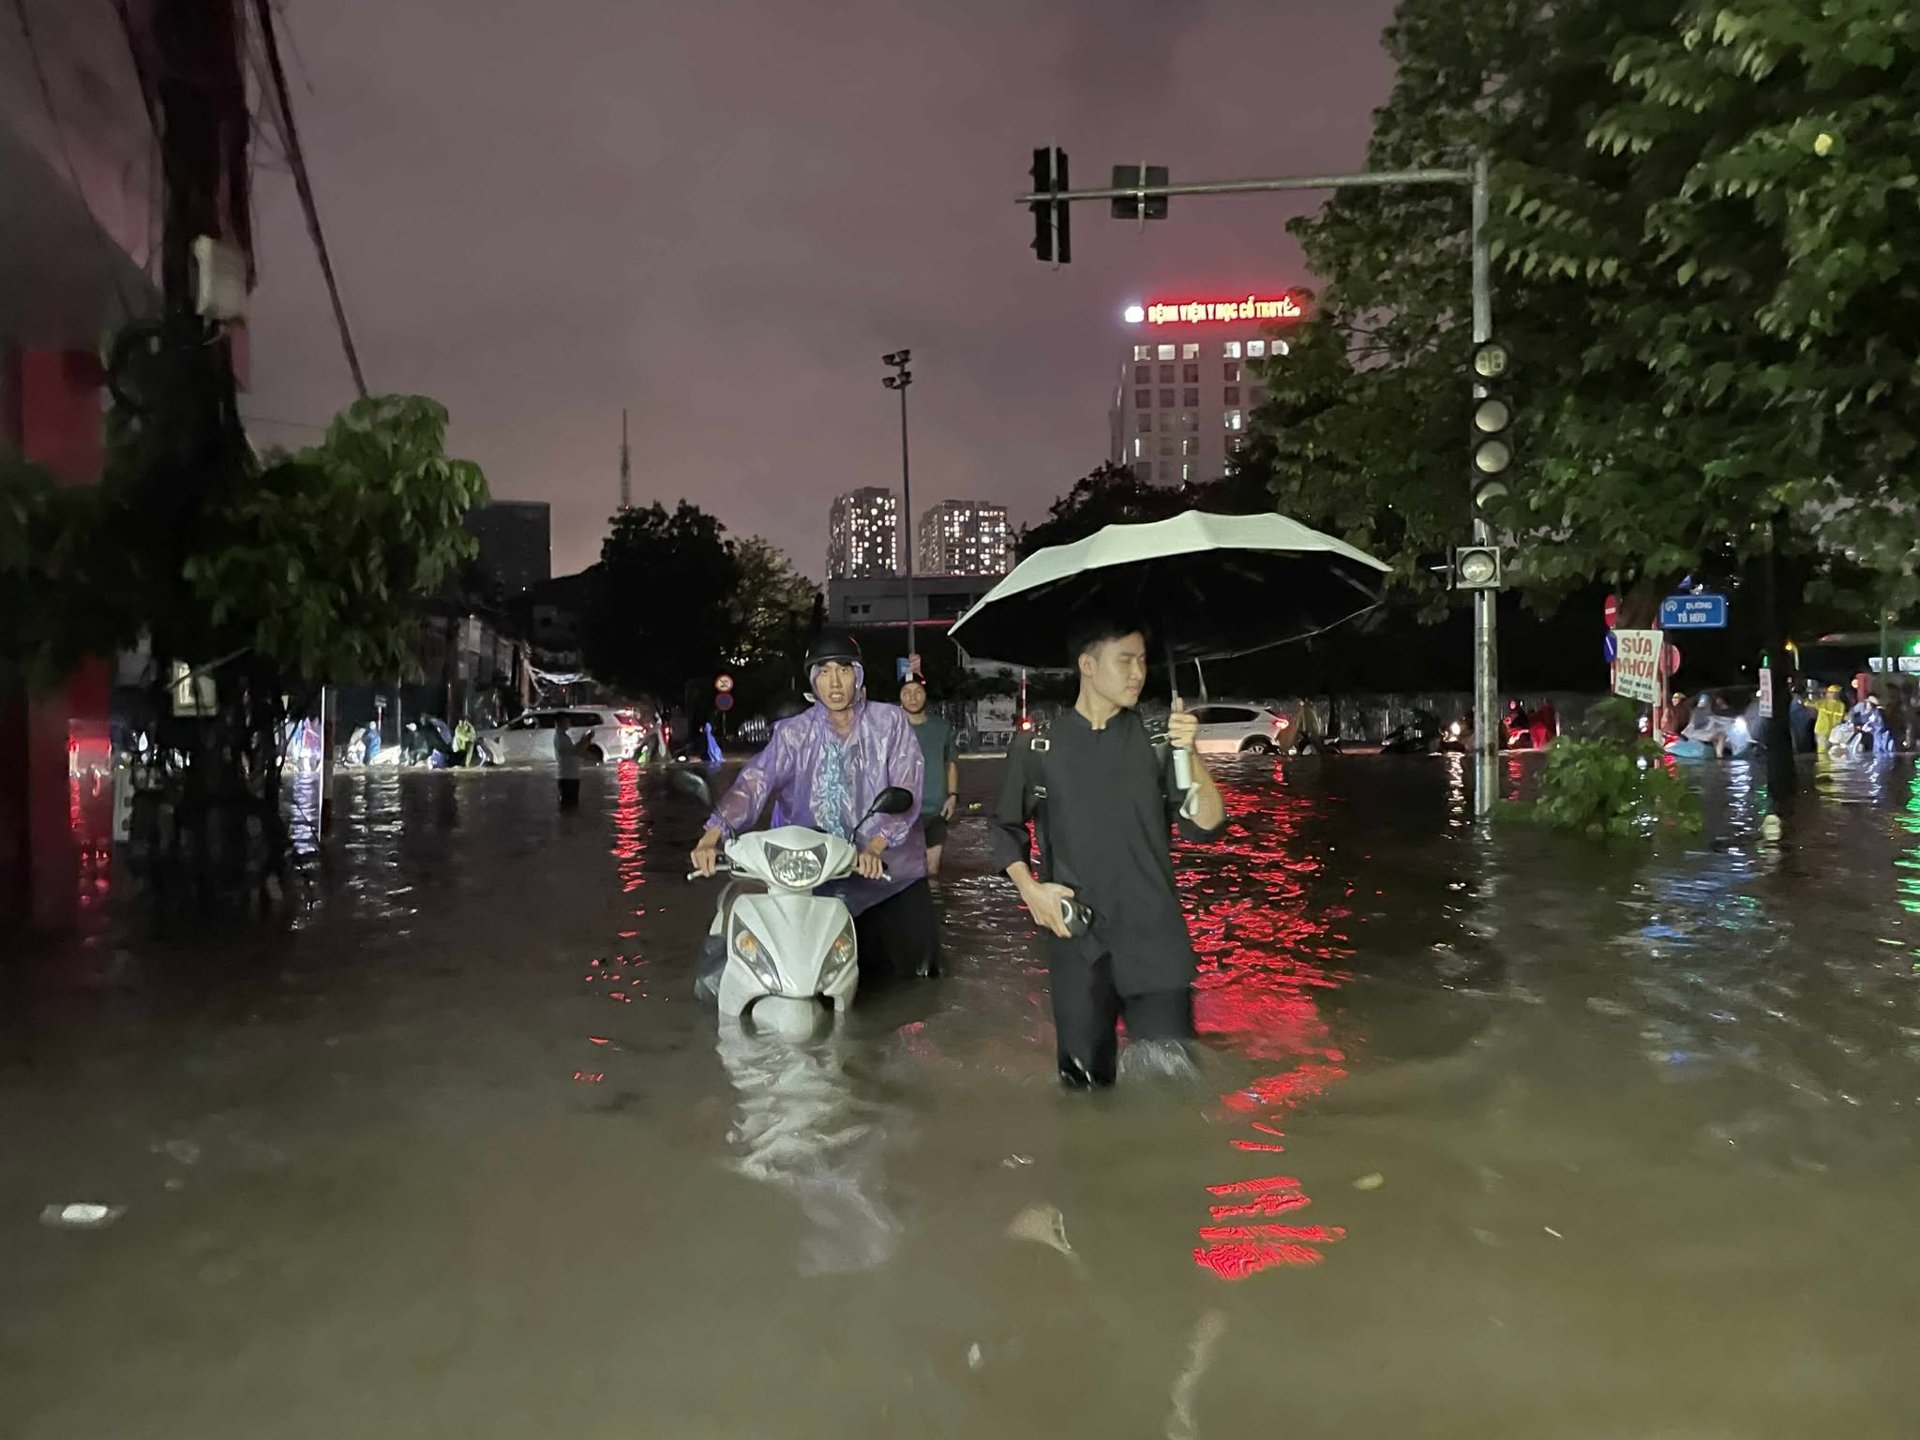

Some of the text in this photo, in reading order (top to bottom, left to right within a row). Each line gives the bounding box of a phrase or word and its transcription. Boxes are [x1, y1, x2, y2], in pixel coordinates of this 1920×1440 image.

[1148, 303, 1178, 324] BỆNH
[1180, 302, 1206, 322] VIỆN
[1207, 304, 1214, 319] Y
[1239, 295, 1254, 318] CỔ
[1621, 631, 1652, 656] SỬA
